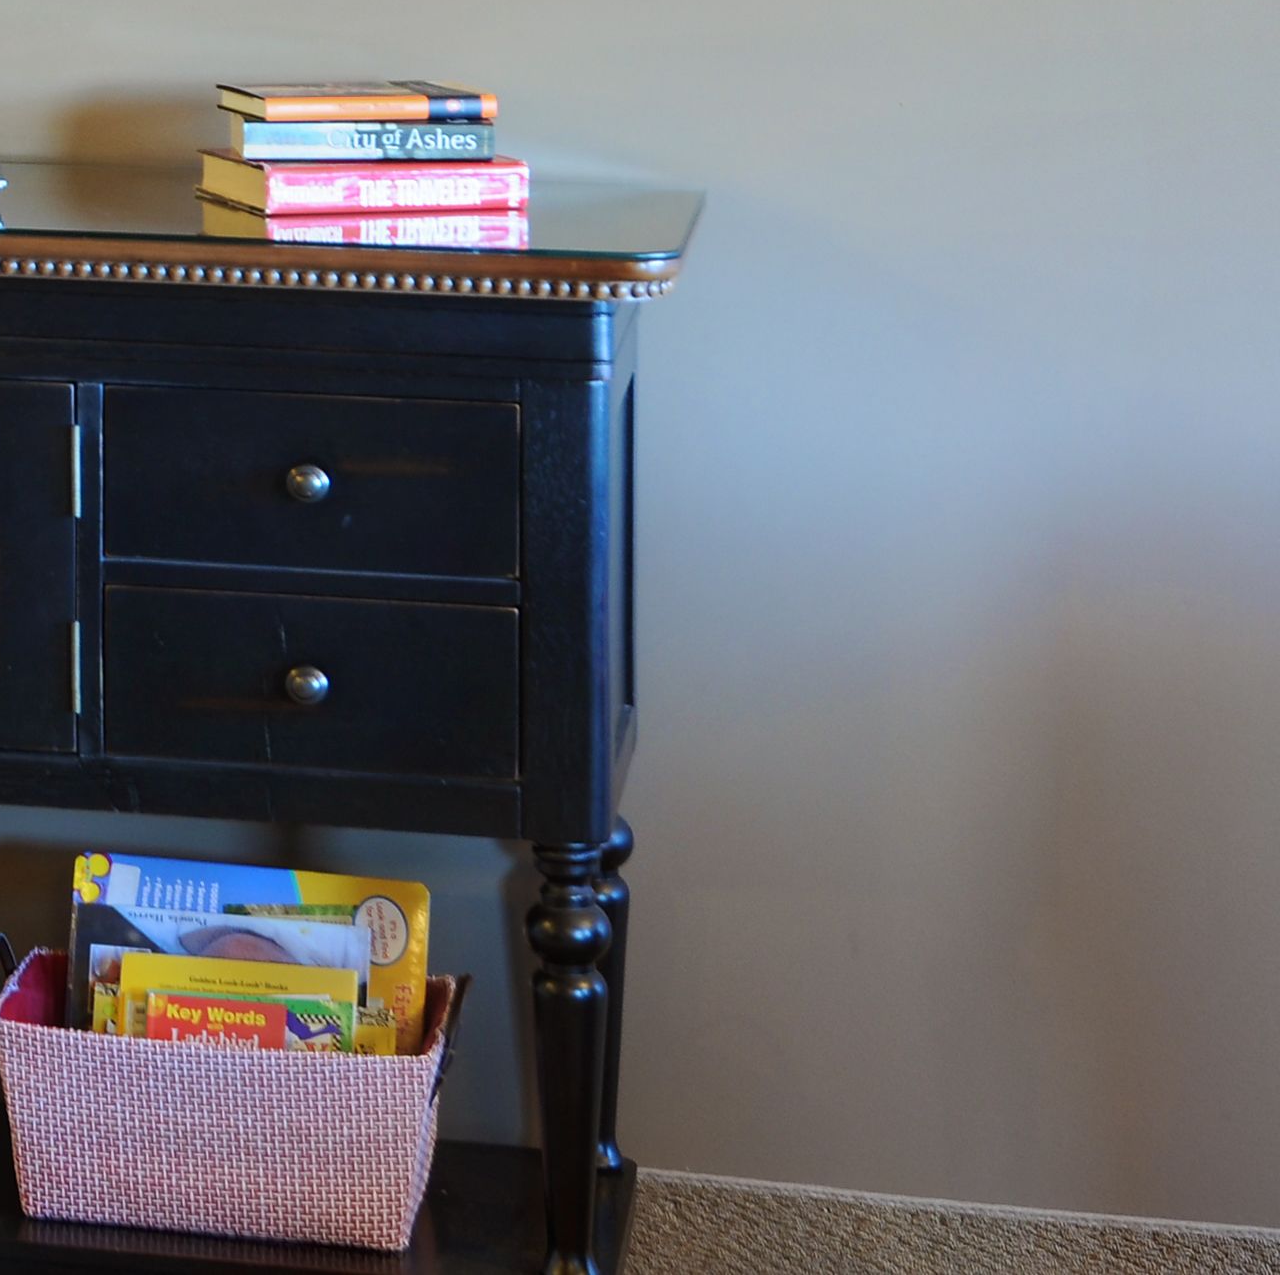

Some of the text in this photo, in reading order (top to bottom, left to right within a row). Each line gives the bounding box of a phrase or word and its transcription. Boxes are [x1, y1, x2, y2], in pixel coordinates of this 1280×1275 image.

[382, 129, 404, 149] of
[405, 128, 478, 151] Ashes
[358, 179, 392, 207] THE
[395, 178, 482, 207] TRAVELER
[166, 1003, 202, 1024] Key
[206, 1005, 267, 1027] Words
[171, 1027, 260, 1050] Ladybird
